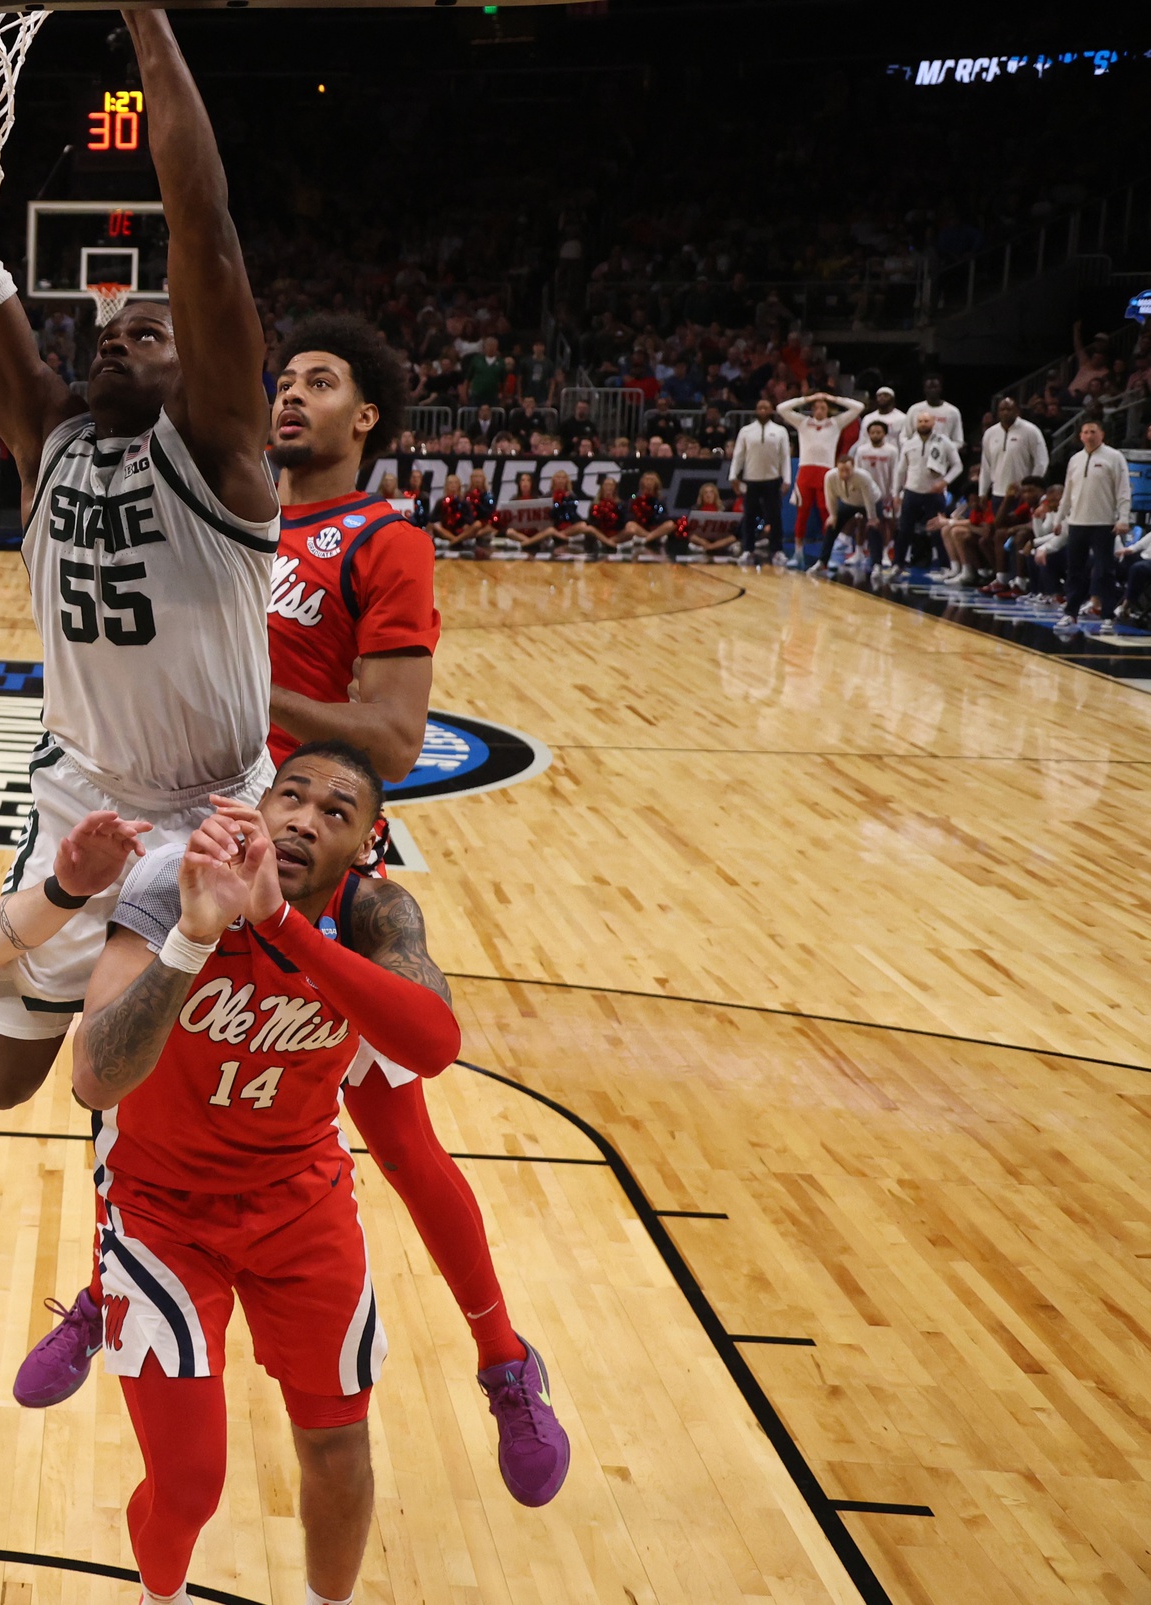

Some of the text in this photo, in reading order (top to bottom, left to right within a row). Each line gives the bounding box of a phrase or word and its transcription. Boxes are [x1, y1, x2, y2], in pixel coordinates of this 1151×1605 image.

[104, 91, 143, 113] 1:27
[87, 112, 139, 150] 30
[50, 484, 167, 553] STATE
[307, 541, 335, 558] GRADUATE
[315, 526, 342, 551] SEC
[59, 558, 157, 646] 55
[321, 927, 337, 936] NCAA
[179, 977, 349, 1053] Ole Miss
[208, 1060, 285, 1109] 14
